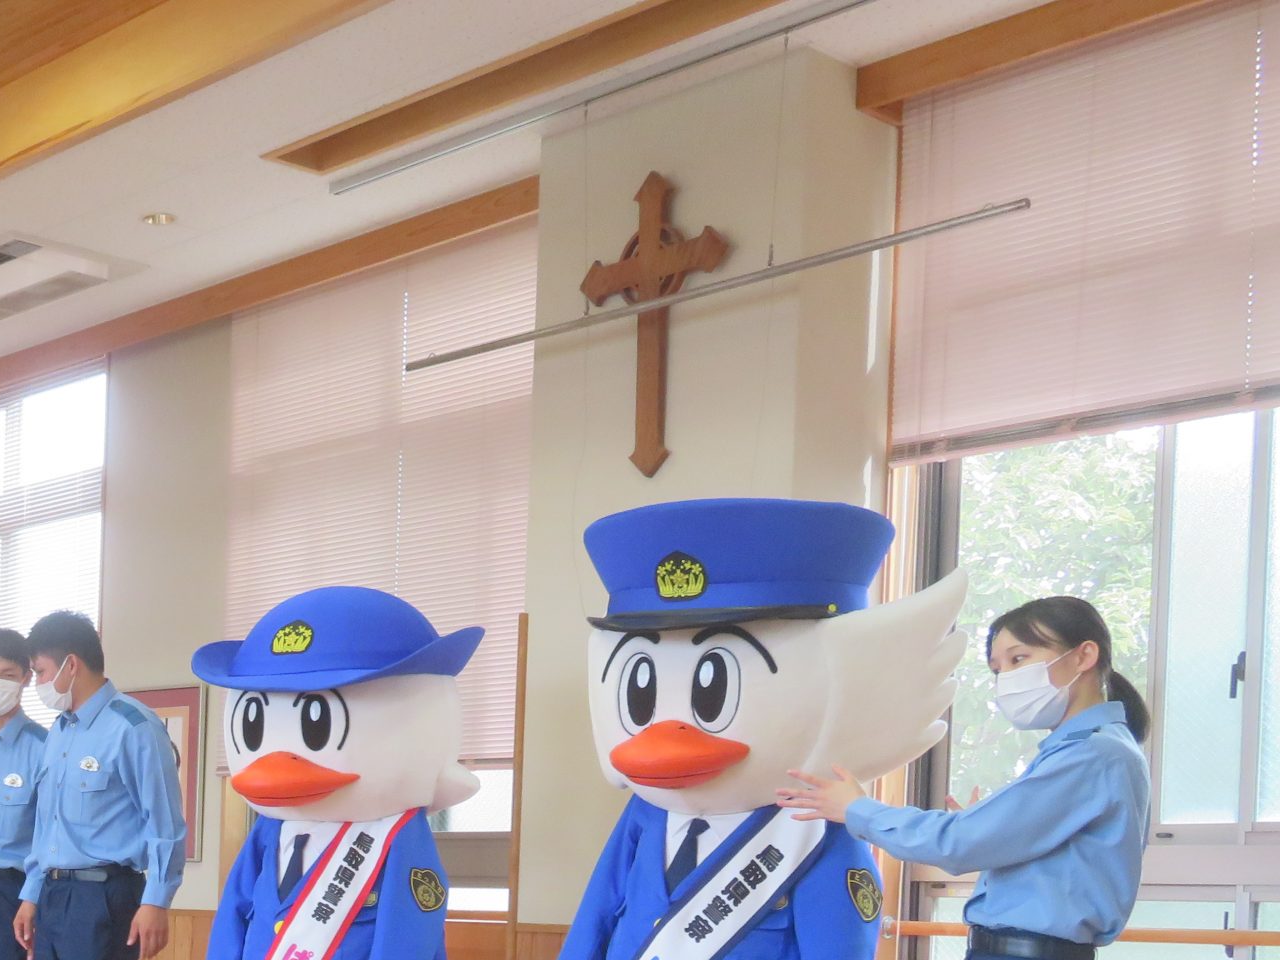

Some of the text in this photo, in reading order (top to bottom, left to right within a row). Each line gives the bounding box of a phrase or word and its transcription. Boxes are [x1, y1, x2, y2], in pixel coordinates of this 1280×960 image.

[311, 832, 375, 924] 鳥取県警察
[683, 844, 785, 943] 鳥取県警察
